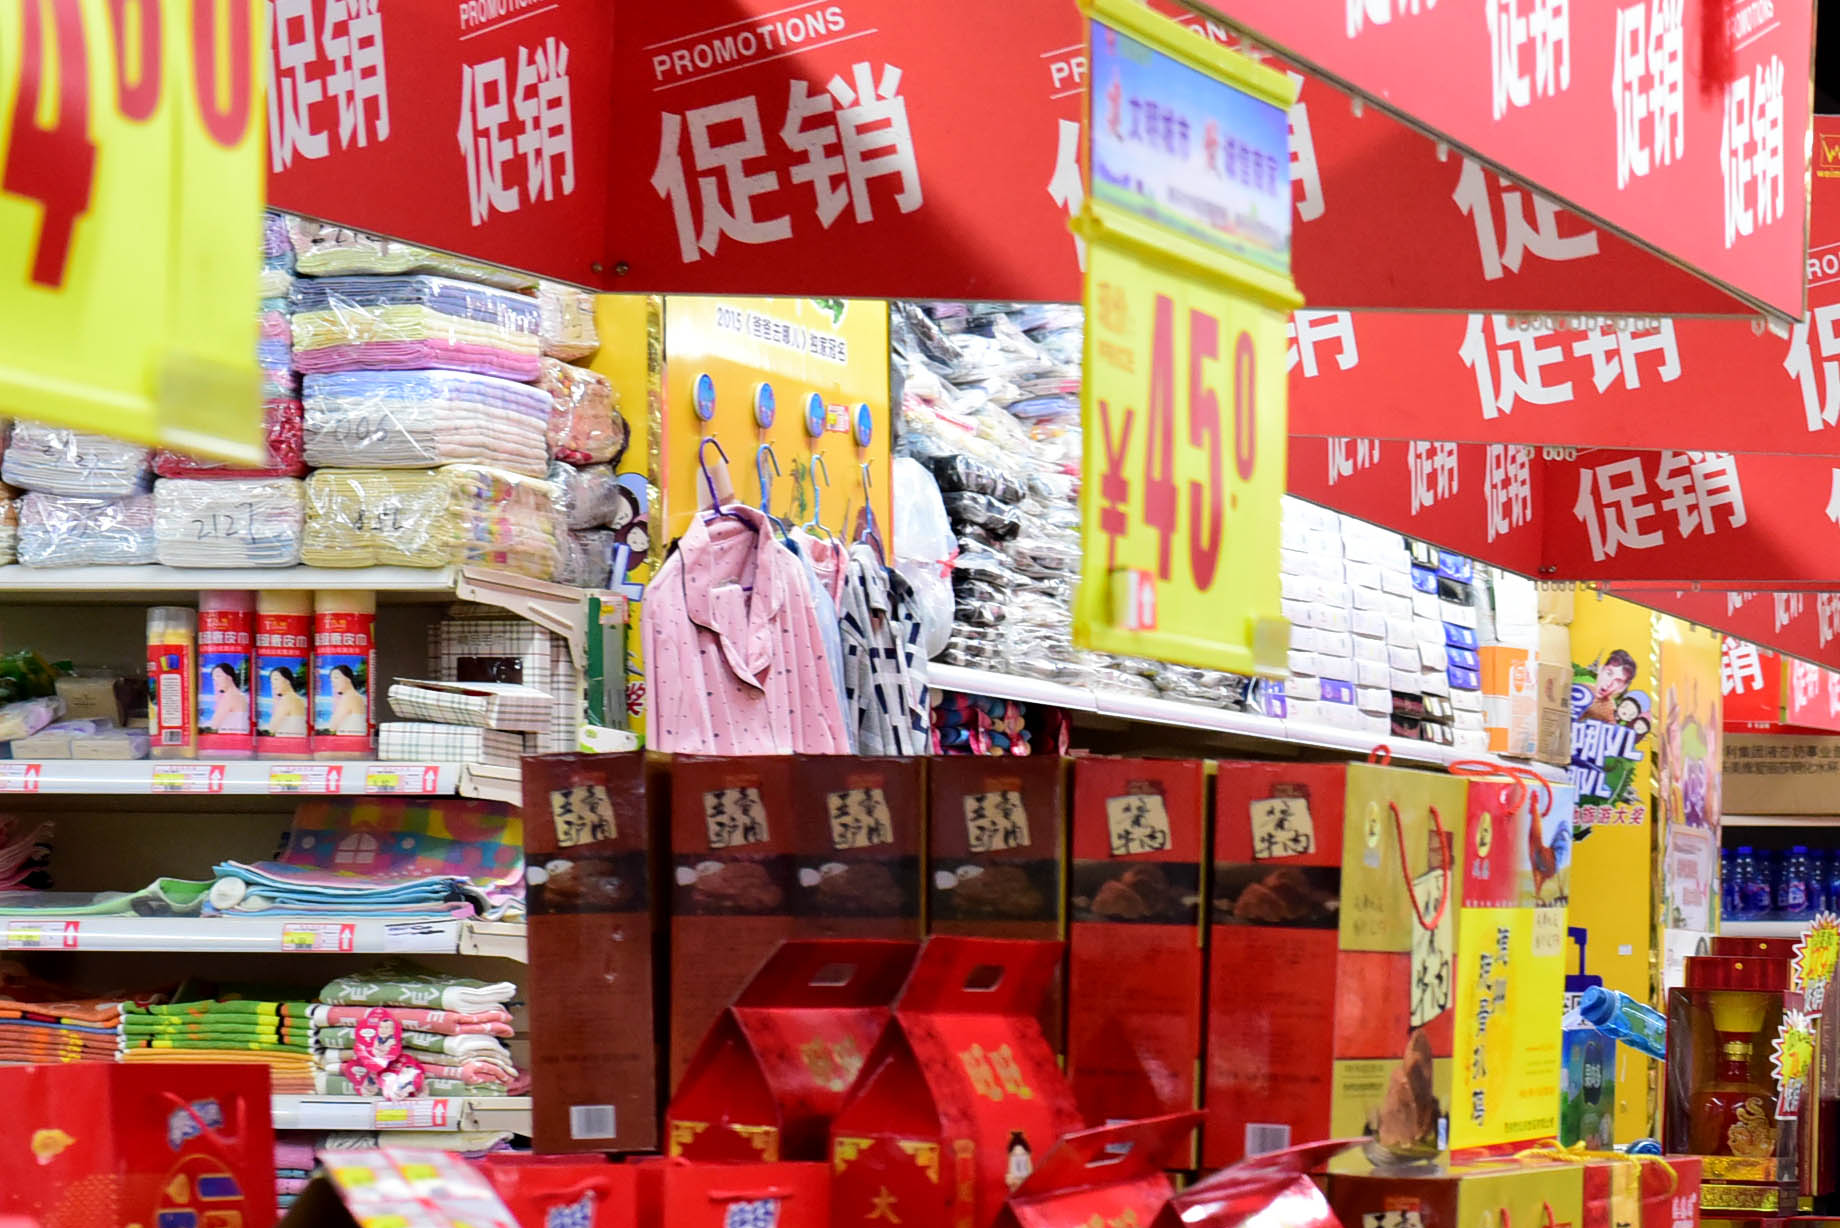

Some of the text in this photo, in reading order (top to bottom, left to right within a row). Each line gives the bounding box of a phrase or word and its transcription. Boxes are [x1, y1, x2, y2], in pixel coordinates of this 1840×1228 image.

[456, 37, 576, 227] 促销
[653, 8, 846, 80] PROMOTIONS
[1612, 0, 1686, 190] 促销
[651, 62, 924, 264] 促销
[1720, 54, 1785, 249] 促销
[1573, 452, 1747, 562] 促销
